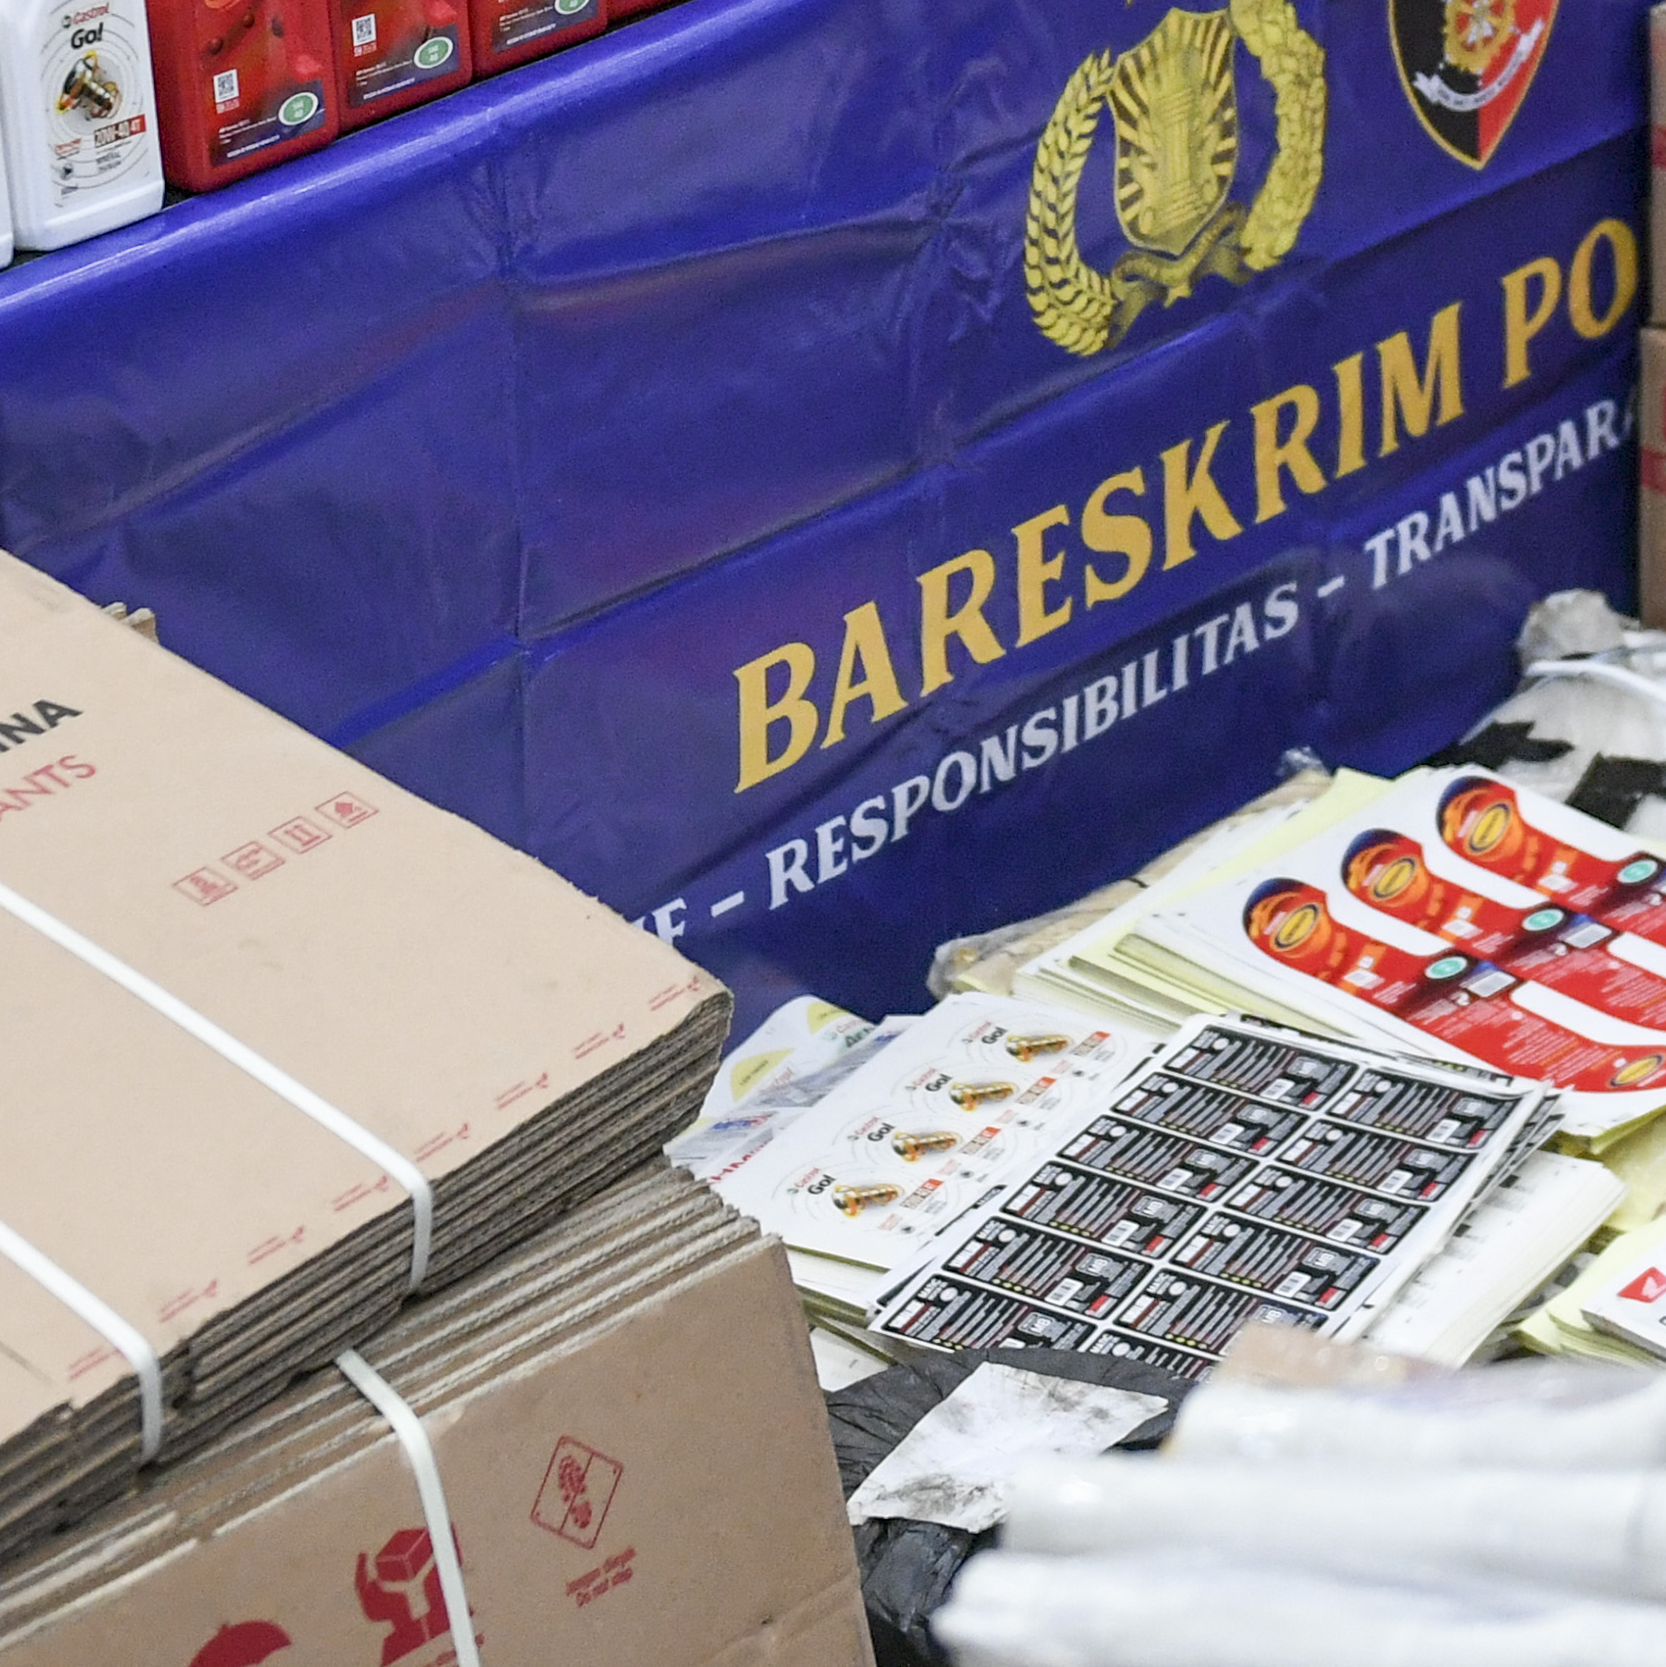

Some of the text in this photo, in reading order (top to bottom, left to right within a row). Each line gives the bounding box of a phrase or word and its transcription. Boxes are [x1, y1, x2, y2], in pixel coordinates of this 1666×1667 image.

[72, 3, 110, 25] Castrol
[71, 22, 104, 50] Go!
[94, 120, 130, 148] 20W-40
[734, 302, 1464, 794] BARESKRIM
[766, 582, 1299, 910] RESPONSIBILITAS
[981, 1027, 1008, 1045] Go!
[924, 1074, 952, 1092] Go!
[867, 1123, 895, 1142] Go!
[808, 1174, 836, 1196] Go!
